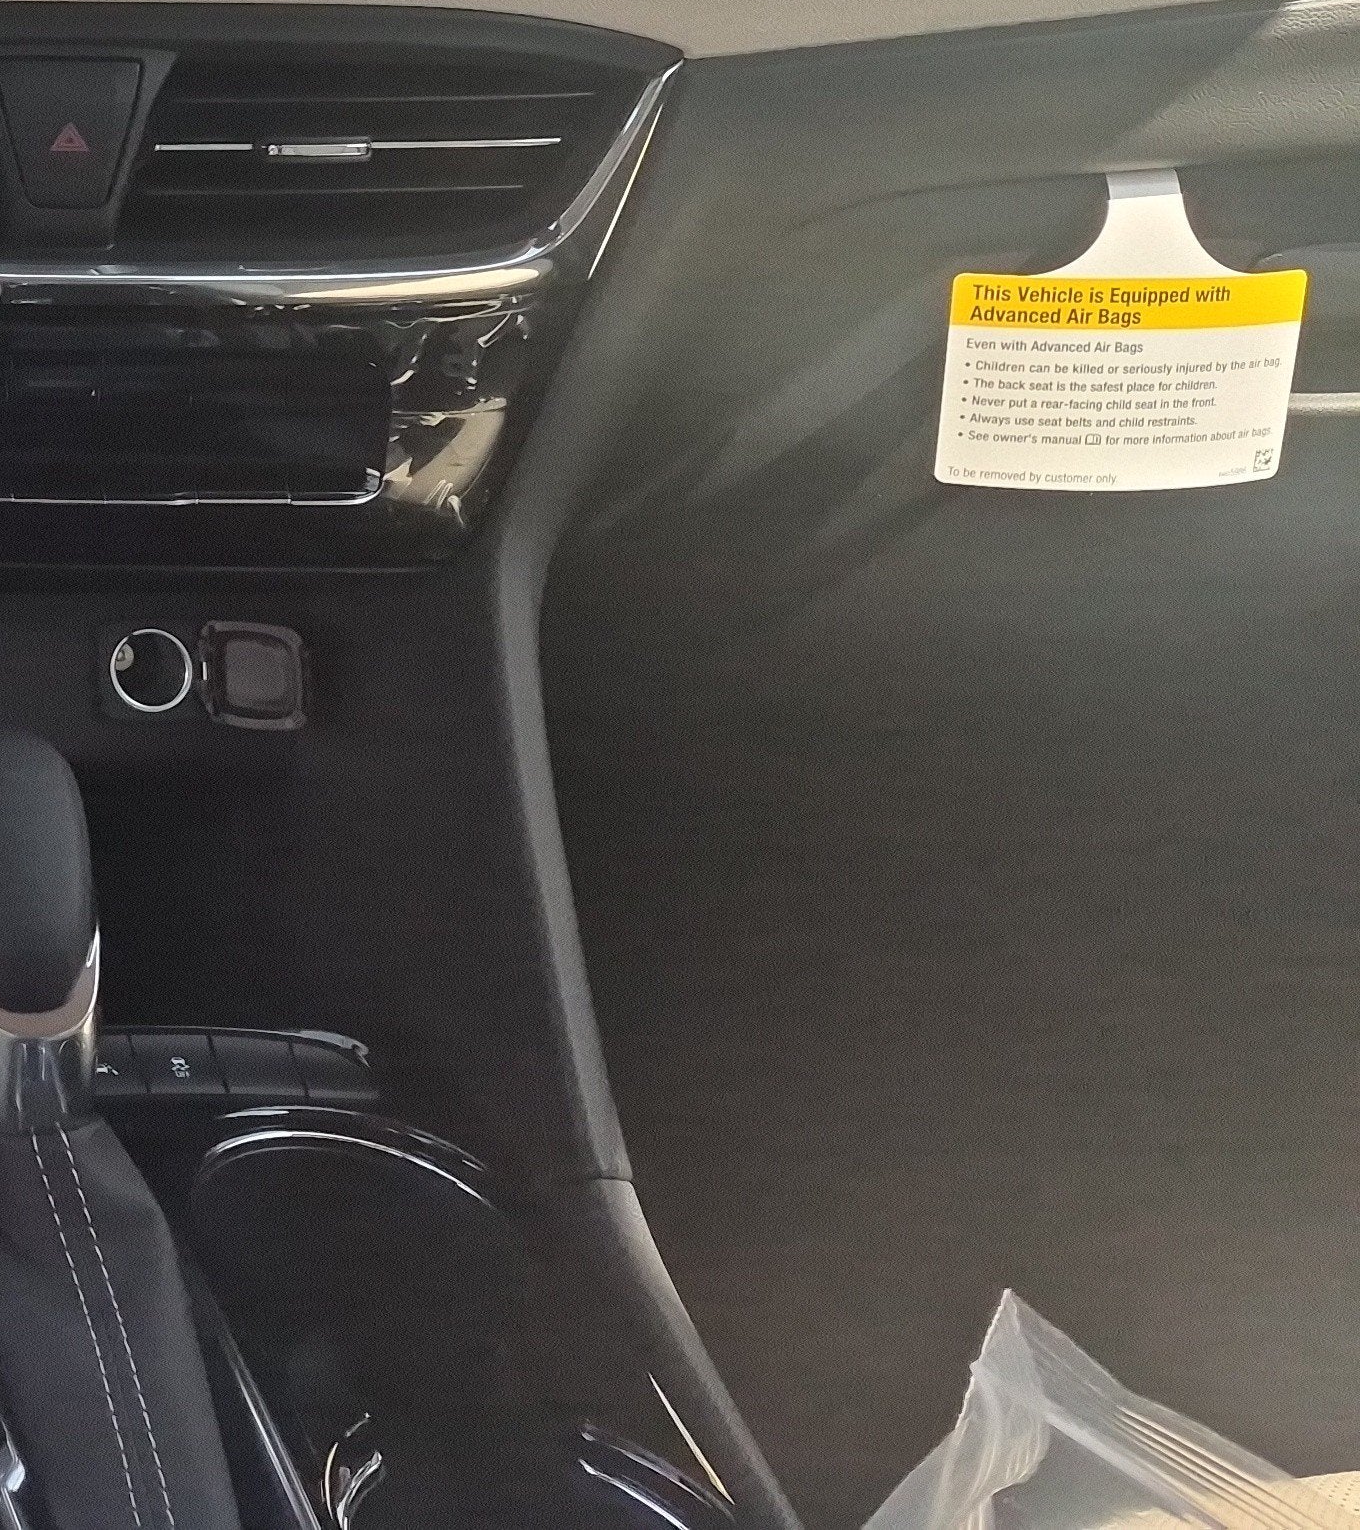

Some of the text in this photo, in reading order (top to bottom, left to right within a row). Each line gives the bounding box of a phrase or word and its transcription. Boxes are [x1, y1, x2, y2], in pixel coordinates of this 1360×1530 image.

[972, 284, 1231, 307] This Vehicle is Equipped with
[970, 305, 1142, 328] Advanced Air Bags
[966, 338, 1144, 355] Even with Advanced Air Bags
[975, 356, 1283, 376] Children can be killed or seriously injured by the air bag.
[973, 378, 1218, 394] The back seat is the safest place for children.
[971, 395, 1217, 412] Never put a rear-facing child seat in the front.
[969, 413, 1198, 428] Always use seat belts and child restraints.
[968, 430, 990, 441] See
[992, 434, 1038, 444] owner's
[1041, 434, 1082, 445] manual
[1105, 434, 1120, 445] for
[1123, 435, 1149, 445] more
[1152, 432, 1208, 445] information
[1210, 430, 1236, 441] about
[1237, 428, 1250, 439] air
[947, 465, 960, 477] To
[962, 467, 976, 478] be
[979, 470, 1026, 482] removed
[1029, 471, 1042, 484] by
[1044, 473, 1092, 484] customer
